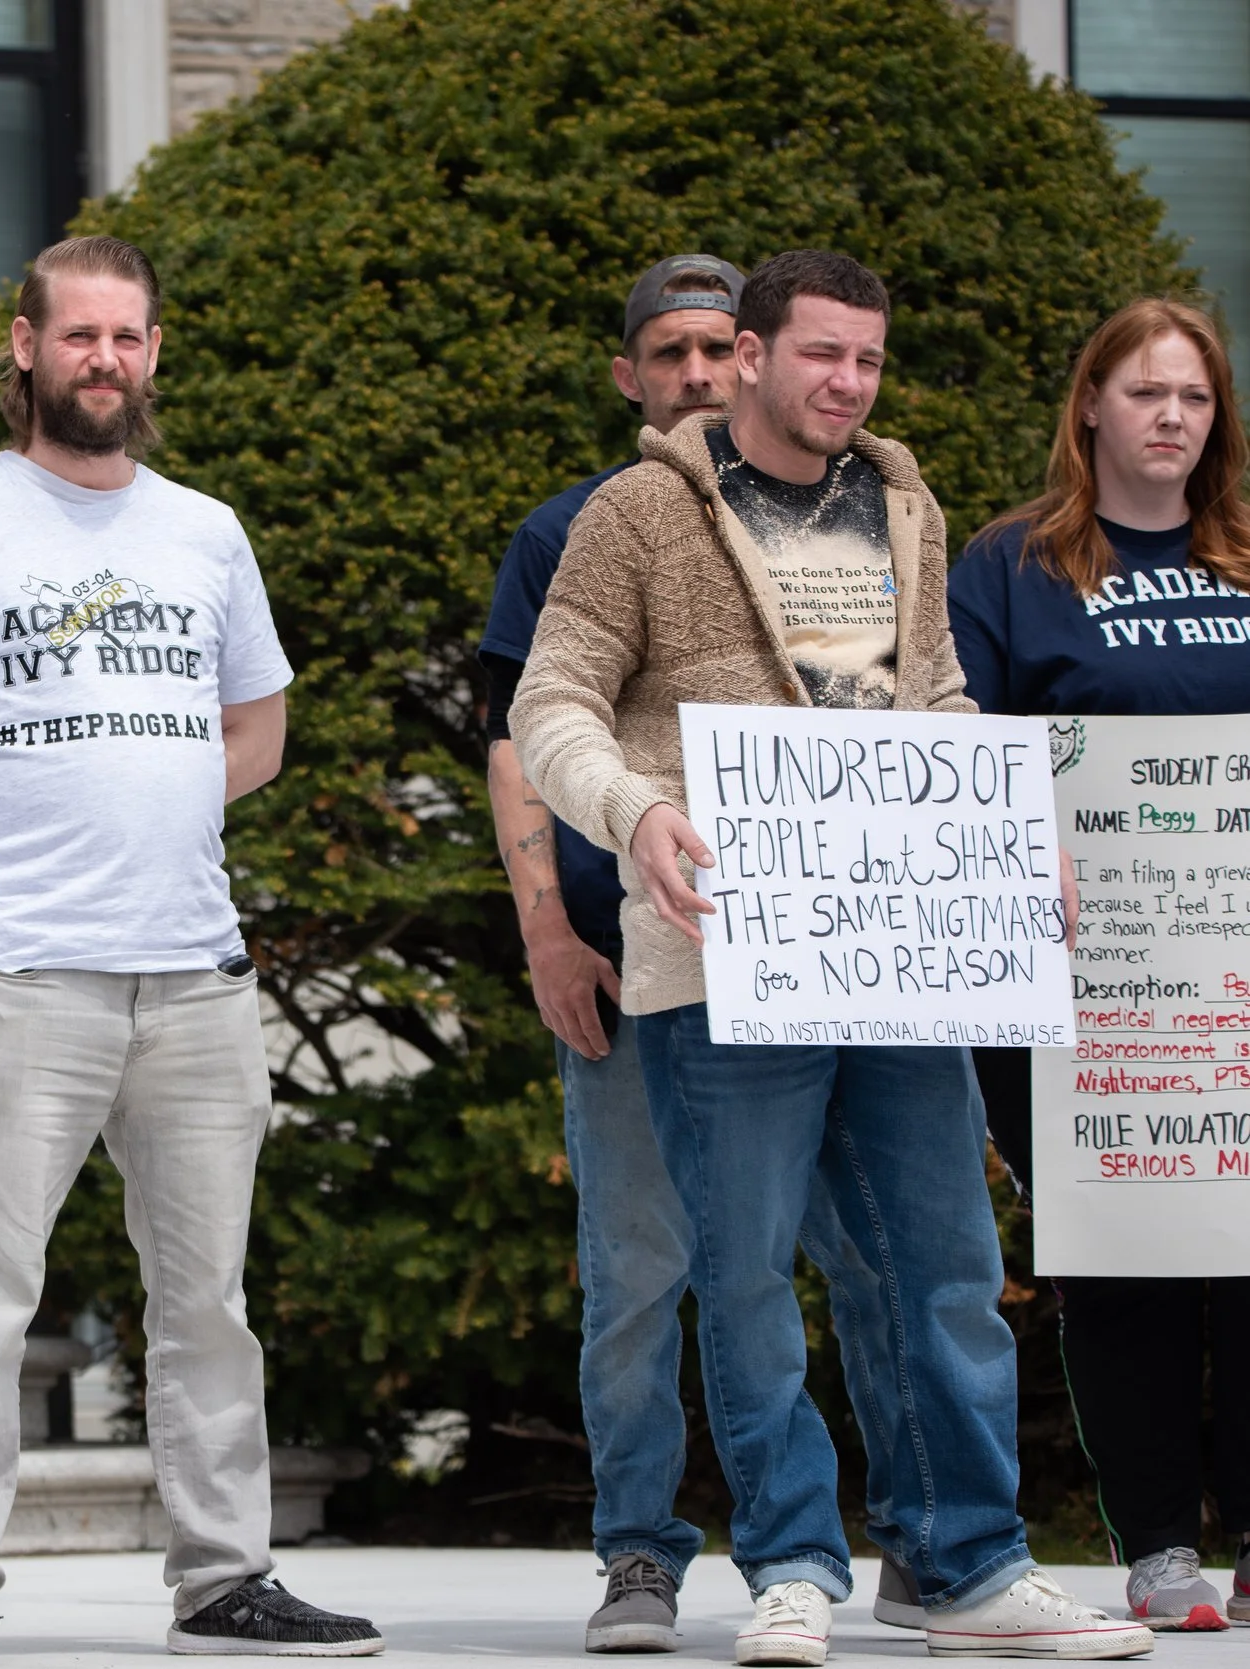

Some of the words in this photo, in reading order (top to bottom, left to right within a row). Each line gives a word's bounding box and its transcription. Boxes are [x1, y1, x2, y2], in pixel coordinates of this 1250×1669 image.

[801, 566, 834, 579] Gone
[835, 567, 862, 579] Too
[778, 582, 801, 594] We
[803, 583, 839, 595] know
[841, 581, 886, 596] you're
[49, 582, 129, 647] SURVIVOR
[779, 599, 840, 612] standing
[842, 598, 875, 610] with
[876, 599, 894, 608] us
[1, 601, 198, 644] ACADEMY
[1099, 618, 1168, 648] IVY
[0, 643, 84, 688] IVY
[95, 643, 203, 682] RIDGE
[0, 711, 211, 747] #THEPROGRAM
[712, 730, 960, 808] HUNDREDS
[971, 743, 1029, 808] OF
[1130, 755, 1220, 786] STUDENT
[1075, 808, 1132, 834] NAME
[1137, 802, 1198, 833] Peggy
[714, 815, 836, 881] PEOPLE
[934, 816, 1051, 882] SHARE
[1073, 858, 1089, 882] I
[1099, 868, 1124, 883] am
[1130, 858, 1176, 894] filing
[1185, 869, 1196, 882] a
[711, 888, 797, 946] THE
[808, 893, 907, 939] SAME
[915, 893, 1068, 945] NIGTMARES
[1077, 890, 1145, 915] because
[1153, 894, 1169, 915] I
[1174, 893, 1210, 916] feel
[1220, 892, 1237, 914] I
[1076, 921, 1097, 937] or
[1102, 917, 1156, 938] shown
[1074, 946, 1154, 964] manner.
[753, 958, 799, 1002] for
[819, 947, 882, 996] NO
[893, 943, 1036, 995] REASON
[1071, 973, 1201, 1009] Description:
[730, 1019, 776, 1045] END
[782, 1019, 930, 1045] INSTITUTIONAL
[933, 1019, 990, 1046] CHILD
[995, 1022, 1066, 1046] ABUSE
[1077, 1005, 1156, 1030] medical
[1075, 1037, 1217, 1061] abandonment
[1074, 1066, 1204, 1097] Nightmares,
[1073, 1113, 1136, 1150] RULE
[1099, 1152, 1197, 1179] SERIOUS
[1216, 1148, 1250, 1178] MI
